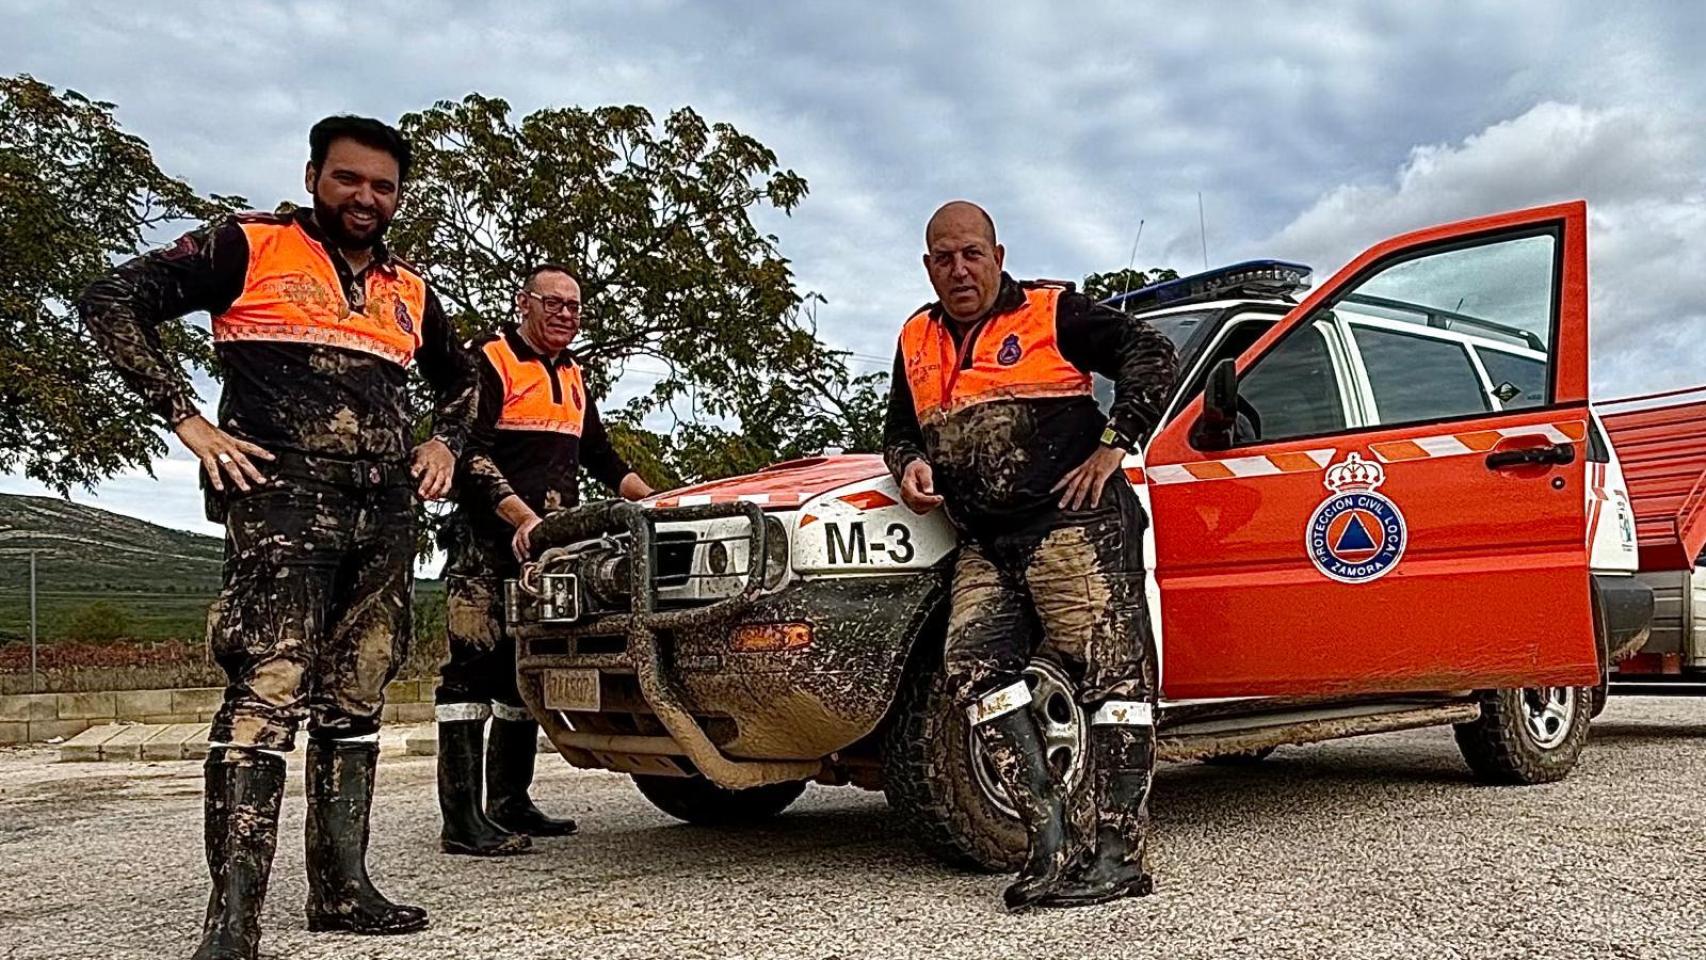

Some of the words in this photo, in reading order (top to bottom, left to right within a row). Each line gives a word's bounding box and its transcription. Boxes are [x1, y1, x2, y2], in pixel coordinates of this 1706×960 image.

[824, 521, 915, 564] M-3
[1314, 497, 1353, 562] PROTECCION
[1358, 497, 1383, 515] CIVIL
[1383, 516, 1398, 557] LOCAL
[1331, 561, 1384, 576] ZAMORA
